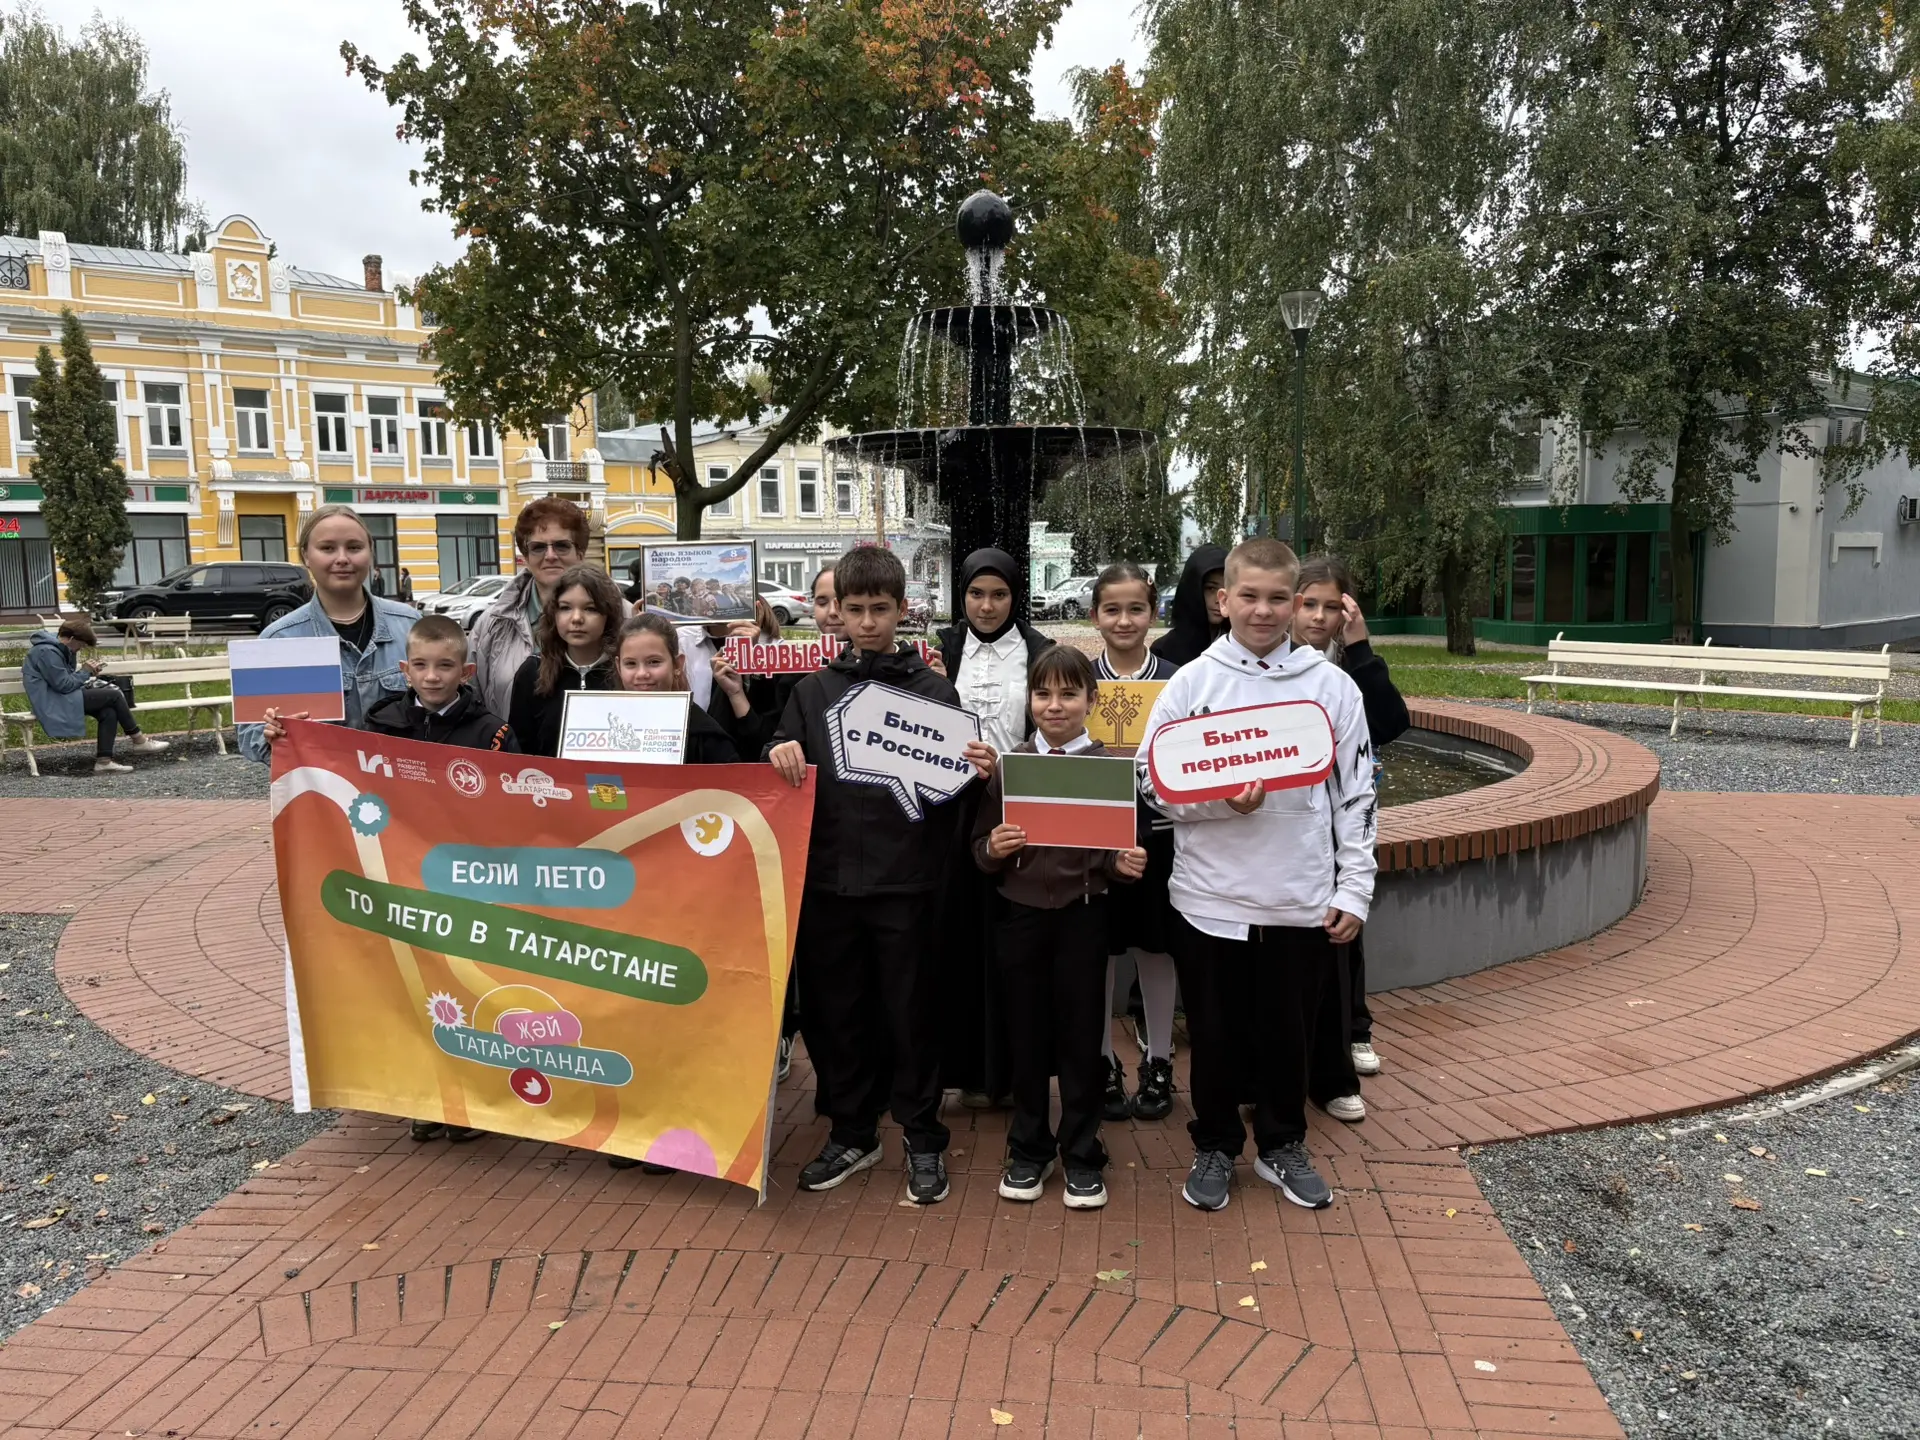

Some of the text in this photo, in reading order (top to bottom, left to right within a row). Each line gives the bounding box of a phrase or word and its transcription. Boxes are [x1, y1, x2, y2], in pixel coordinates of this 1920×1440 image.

[566, 732, 607, 748] 2026
[884, 711, 945, 742] Быть
[1203, 727, 1269, 747] Быть
[847, 729, 969, 774] с Россией
[1181, 745, 1299, 775] первыми
[518, 785, 567, 798] ТАТАРСТАНЕ
[452, 861, 606, 890] ЕСЛИ ЛЕТО
[345, 887, 678, 988] ТО ЛЕТО В ТАТАРСТАНЕ
[455, 1032, 606, 1077] ТАТАРСТАНДА
